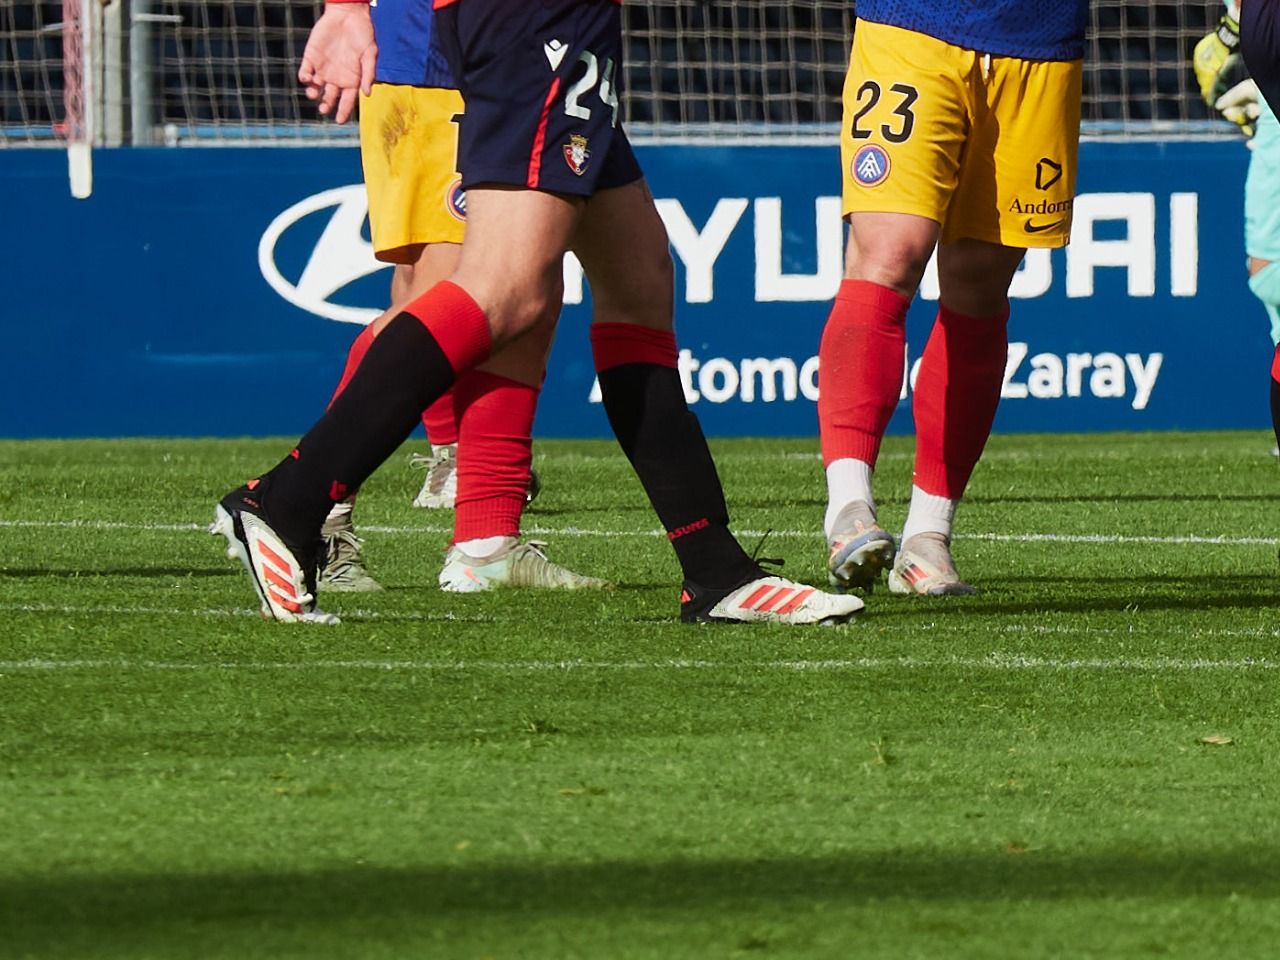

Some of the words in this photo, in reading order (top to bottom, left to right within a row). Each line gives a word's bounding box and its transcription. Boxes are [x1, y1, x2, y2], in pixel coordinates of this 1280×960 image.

[565, 49, 619, 129] 24
[851, 80, 919, 144] 23
[562, 192, 1199, 304] YUAI
[1000, 341, 1164, 411] Zaray
